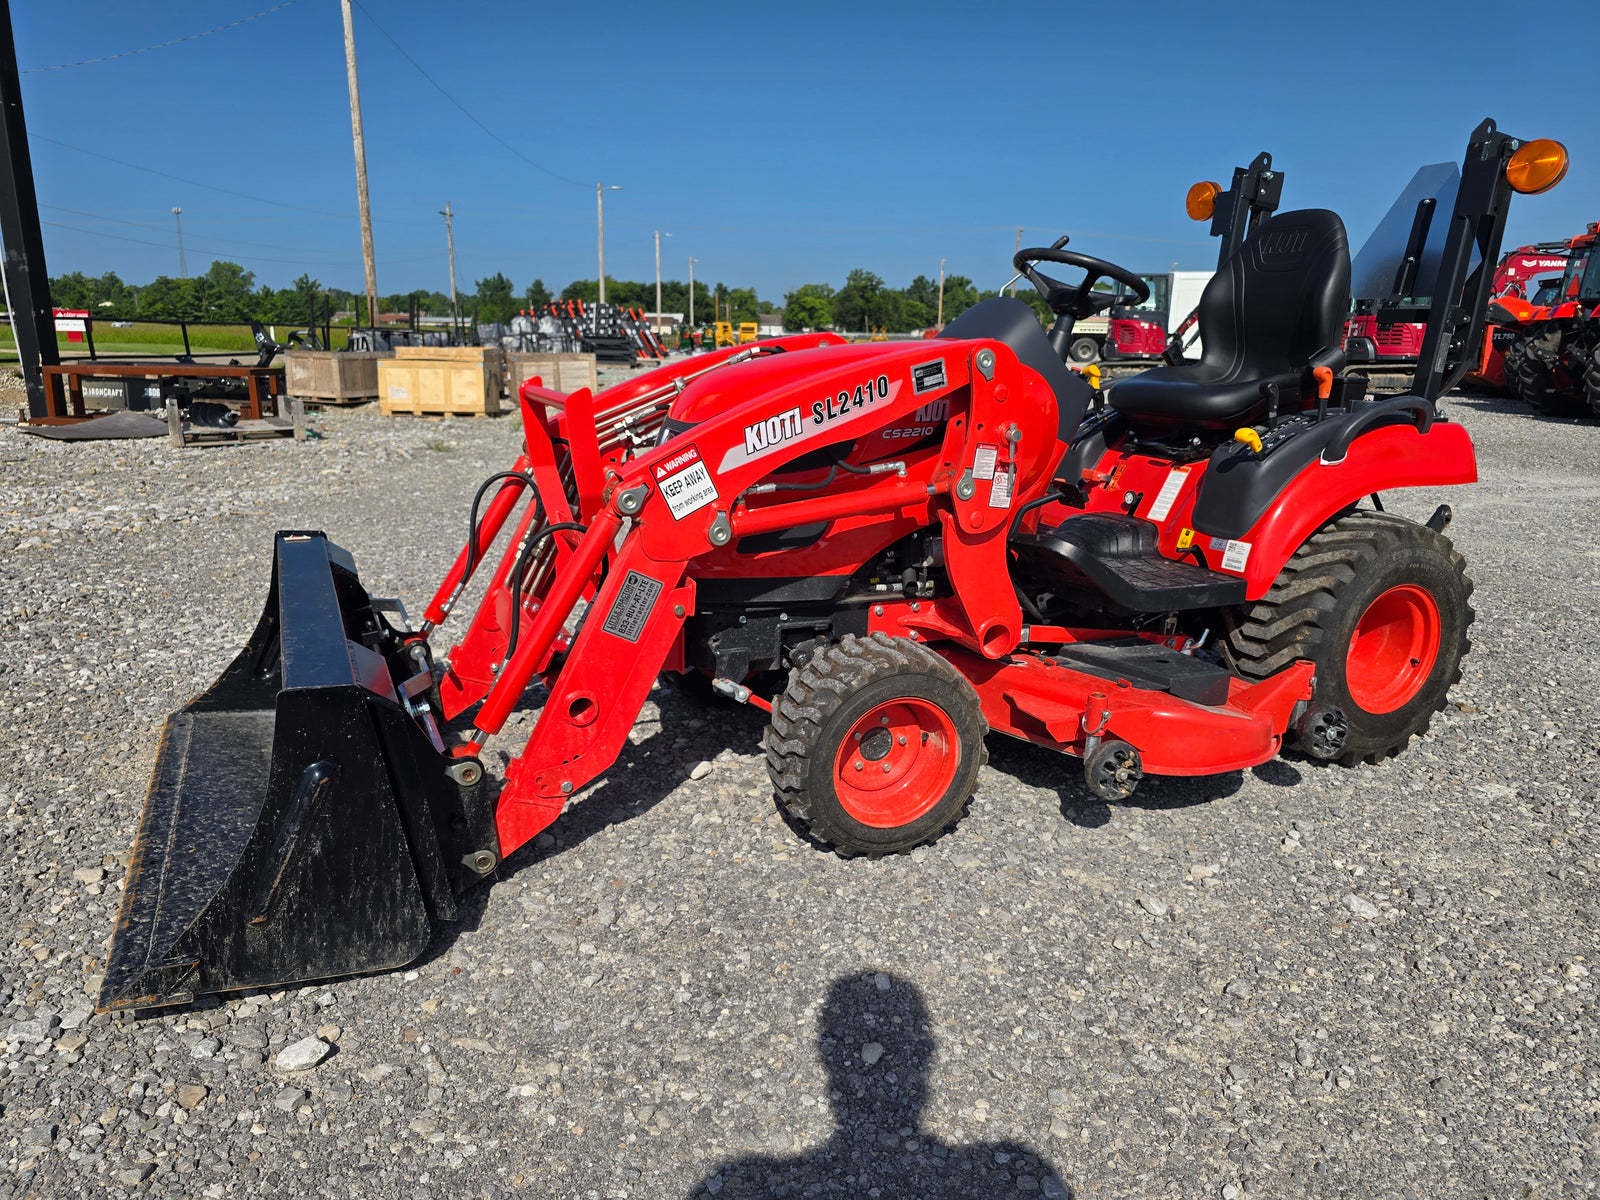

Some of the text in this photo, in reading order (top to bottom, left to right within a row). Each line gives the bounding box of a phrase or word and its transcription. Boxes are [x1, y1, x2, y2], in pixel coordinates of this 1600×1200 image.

[88, 387, 123, 397] IRONCRAFT
[744, 406, 803, 455] KIOTI
[812, 375, 889, 426] SL2410
[914, 399, 951, 422] KIOT
[882, 426, 934, 439] CS2210
[664, 449, 697, 472] WARNING
[663, 467, 706, 499] KEEP AWAY
[672, 486, 714, 513] from working area
[618, 579, 648, 634] 833-BUY-AT-LTE
[625, 581, 655, 636] littletractor.com
